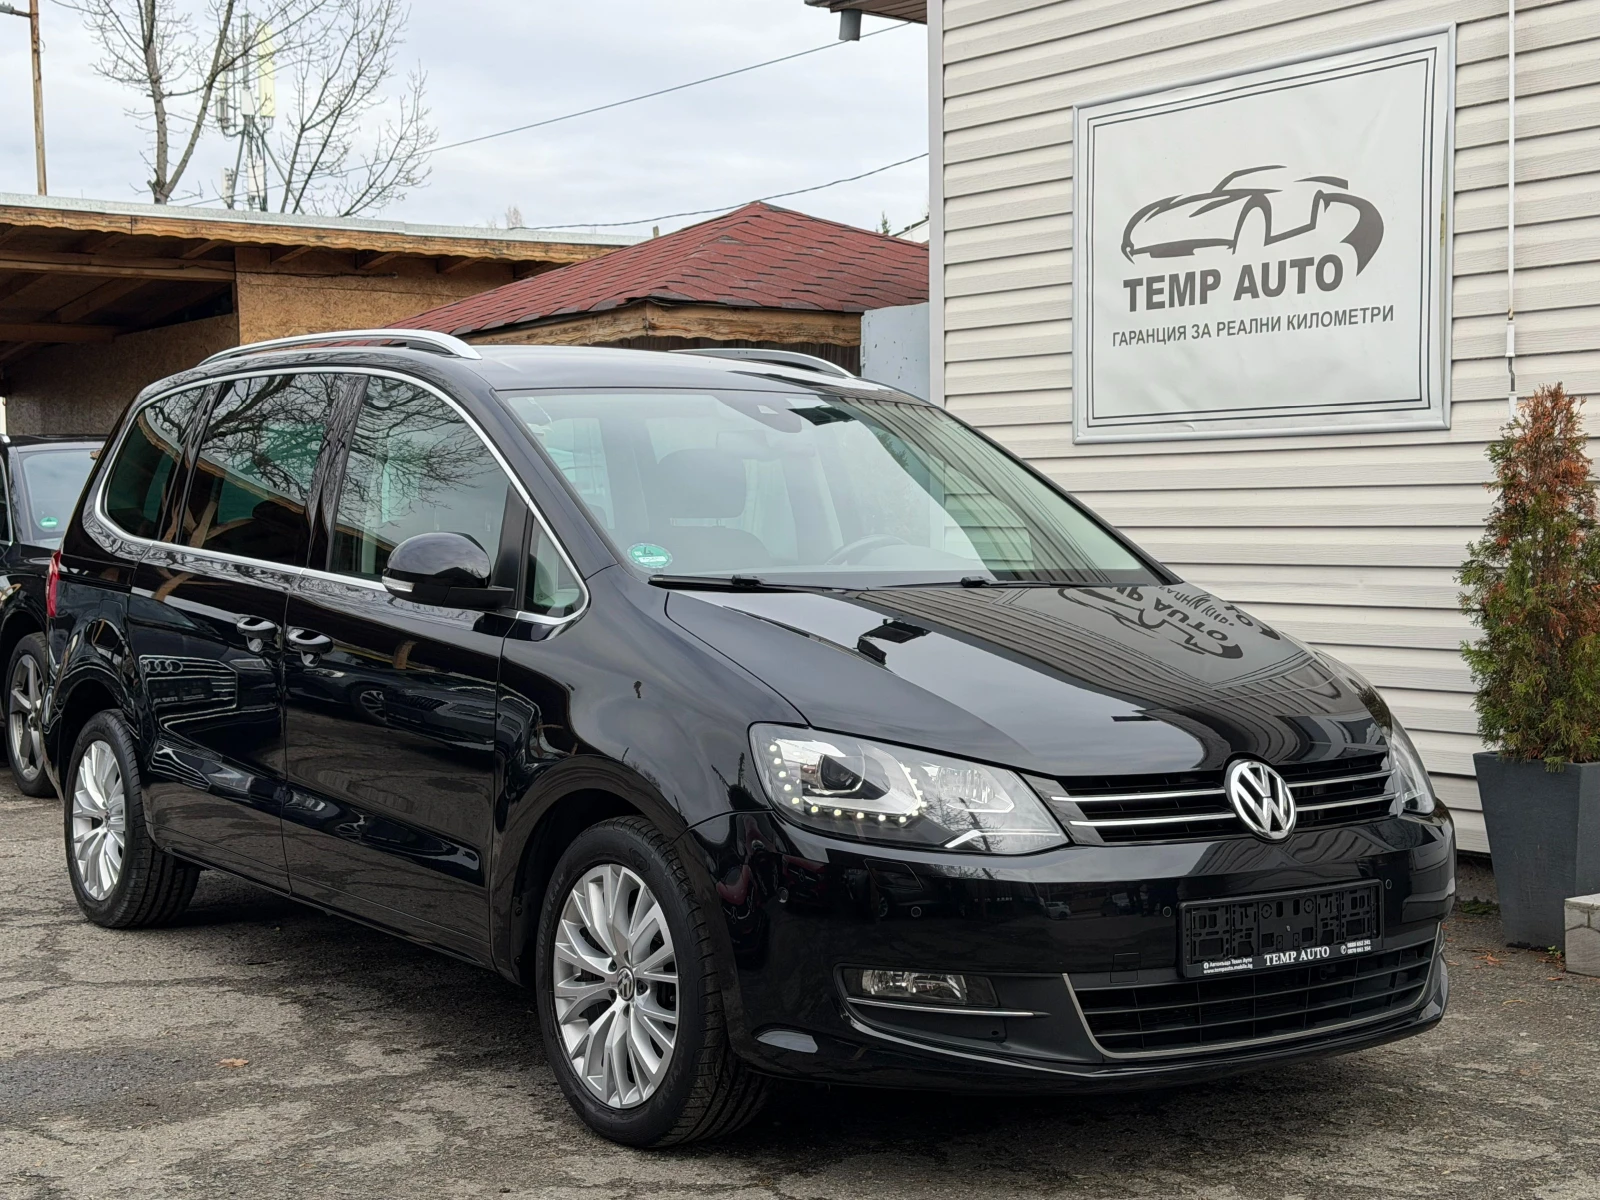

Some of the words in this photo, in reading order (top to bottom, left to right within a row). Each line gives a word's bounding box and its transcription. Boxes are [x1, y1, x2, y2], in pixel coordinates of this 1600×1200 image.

[1123, 269, 1221, 312] TEMP
[1233, 254, 1343, 301] AUTO
[1112, 324, 1187, 347] ГАРАНЦИЯ
[1191, 323, 1212, 340] ЗА
[1216, 315, 1282, 336] РЕАЛНИ
[1286, 304, 1395, 331] КИЛОМЕТРИ
[1264, 951, 1297, 966] TEMP
[1299, 946, 1330, 961] AUTO
